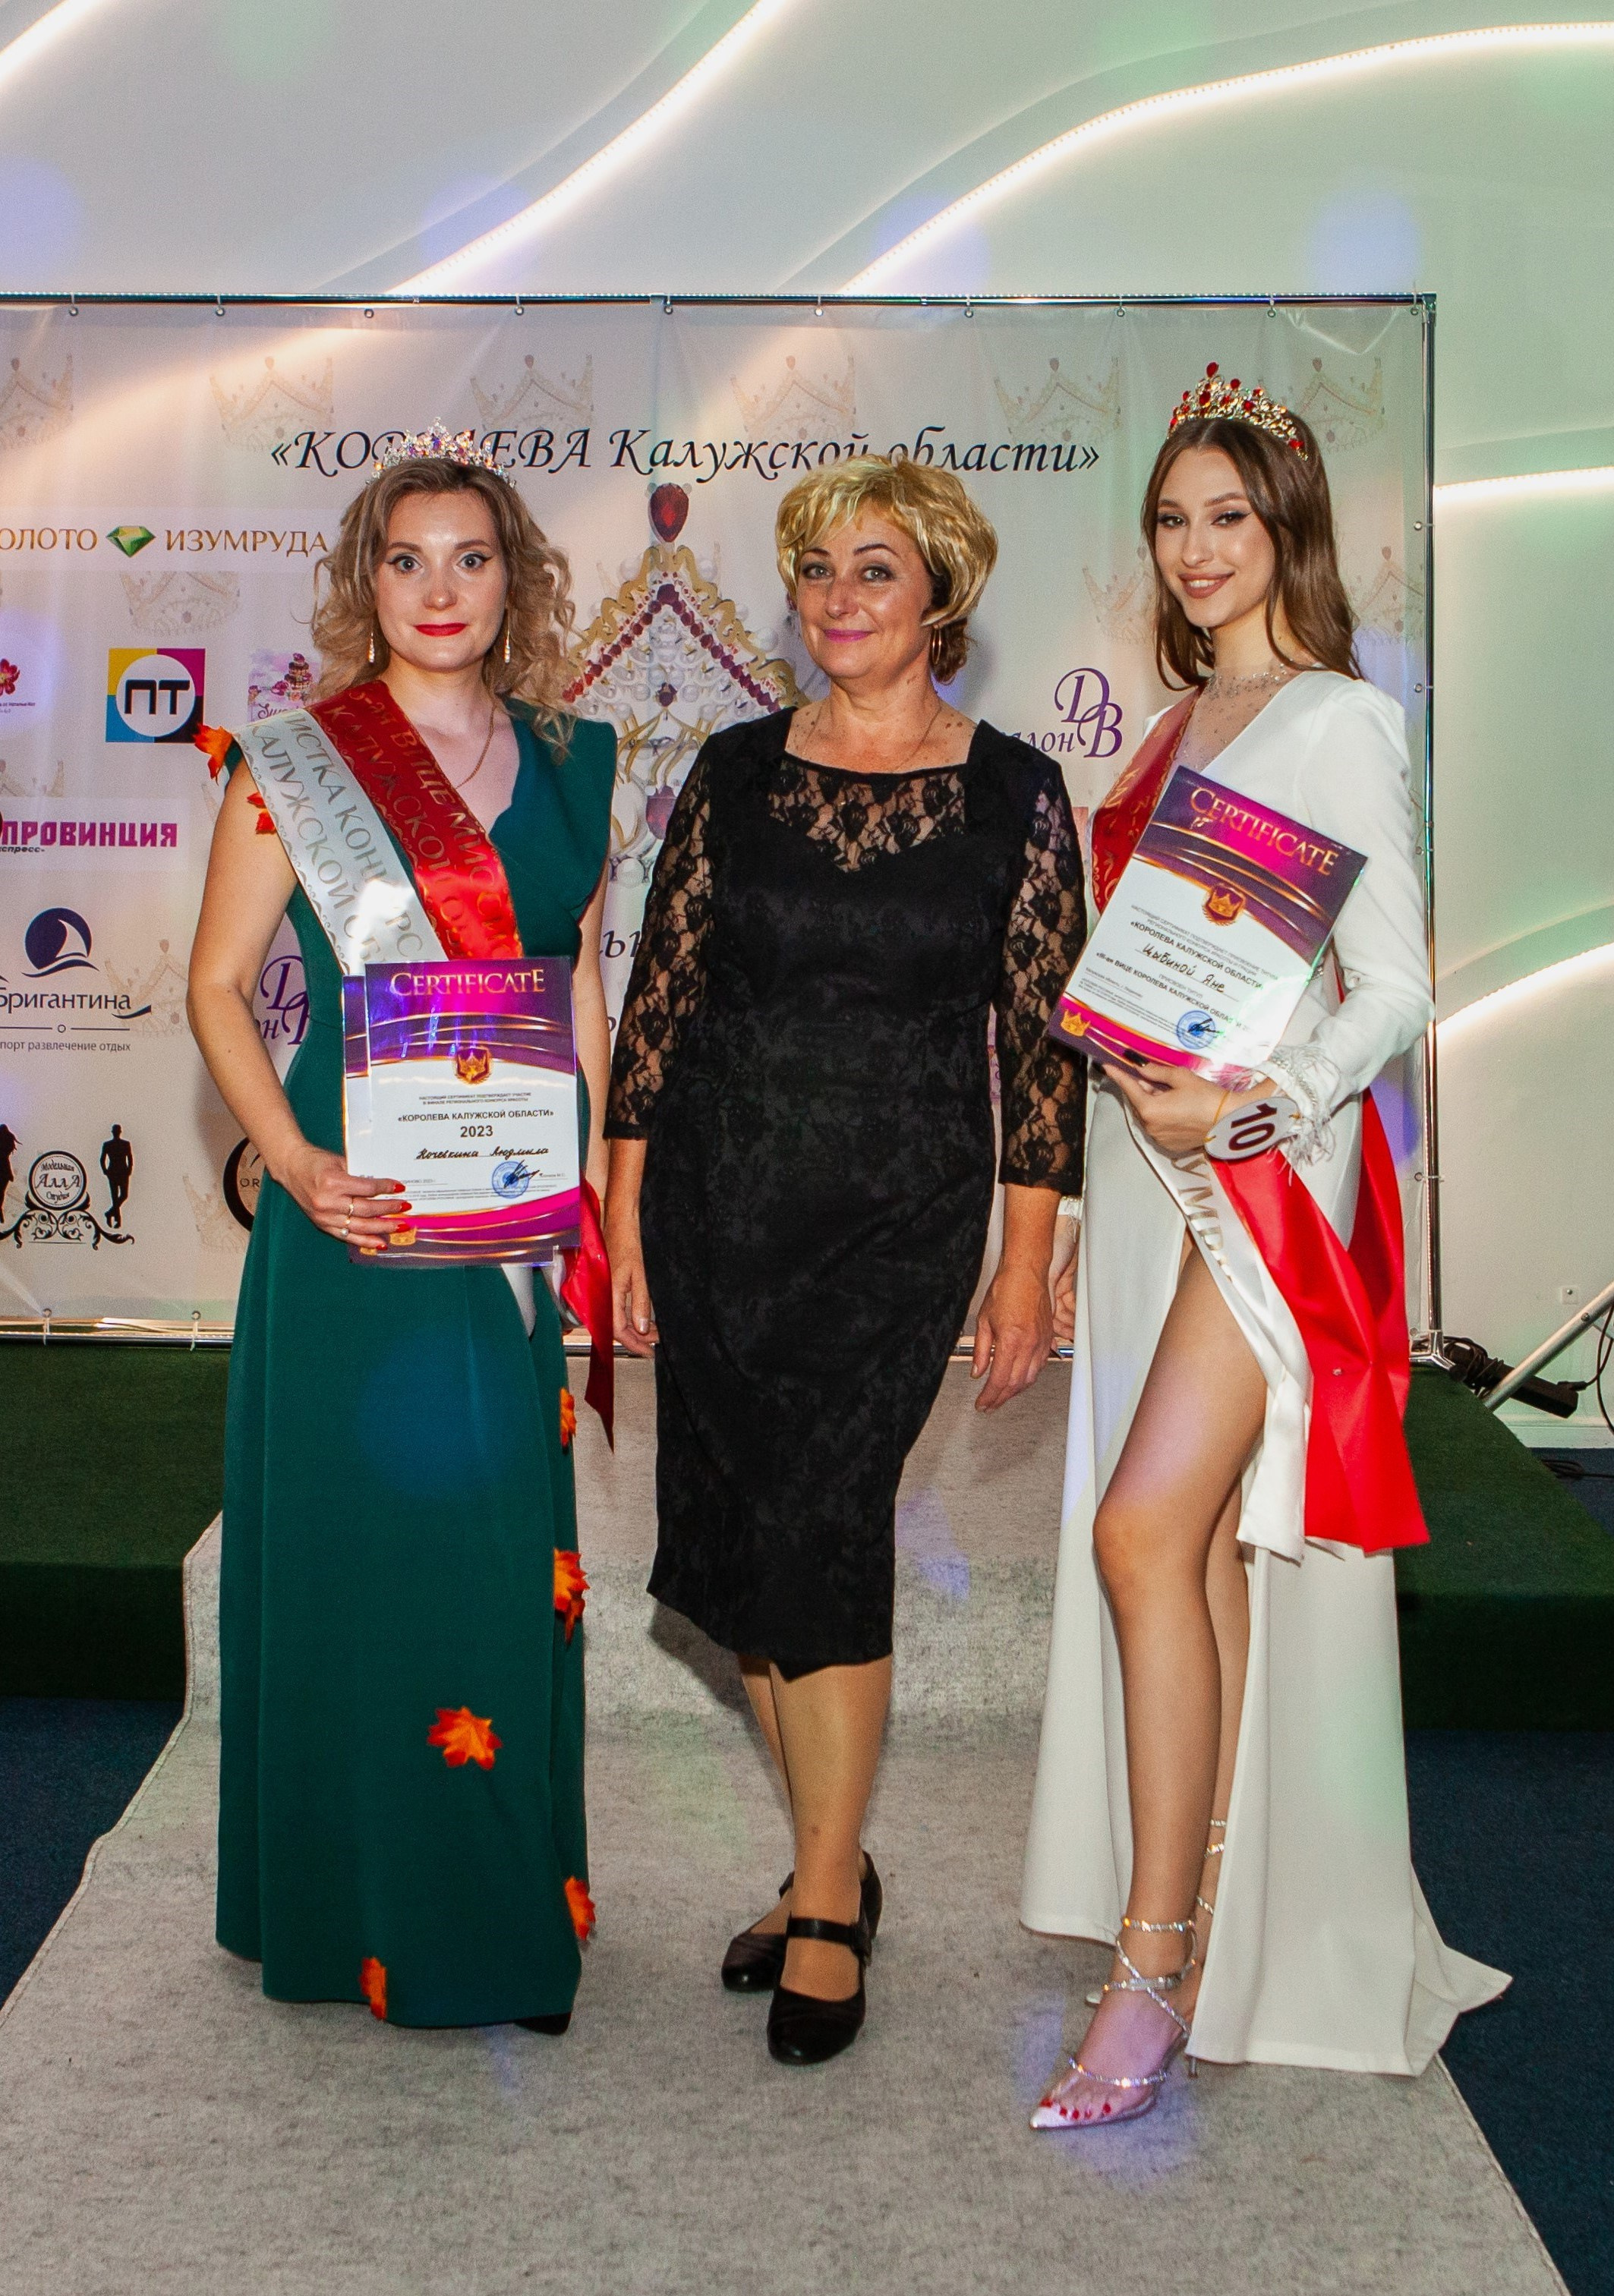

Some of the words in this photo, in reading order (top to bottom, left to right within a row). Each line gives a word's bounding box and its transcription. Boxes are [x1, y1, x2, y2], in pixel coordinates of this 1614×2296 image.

[608, 427, 868, 483] Калужской
[165, 528, 328, 558] ИЗУМРУДА
[125, 679, 190, 714] ПТ
[391, 731, 454, 805] ВИЦЕ
[2, 820, 178, 847] ПРОВИНЦИЯ
[1190, 787, 1339, 876] CERTIFICATE
[1129, 919, 1175, 946] «КОРОЛЕВА
[1175, 941, 1224, 970] КАЛУЖСКОЙ
[390, 967, 546, 997] CERTIFICATE
[1114, 959, 1133, 973] ВИЦЕ
[1132, 968, 1168, 991] КОРОЛЕВА
[1168, 985, 1209, 1012] КАЛУЖСКОЙ
[1202, 972, 1229, 994] Яне
[28, 1041, 96, 1052] развлечение
[99, 1042, 131, 1052] отдых
[398, 1113, 449, 1122] «КОРОЛЕВА
[452, 1110, 506, 1120] КАЛУЖСКОЙ
[508, 1109, 554, 1118] ОБЛАСТИ»
[460, 1125, 493, 1138] 2023
[1228, 1102, 1278, 1152] 10
